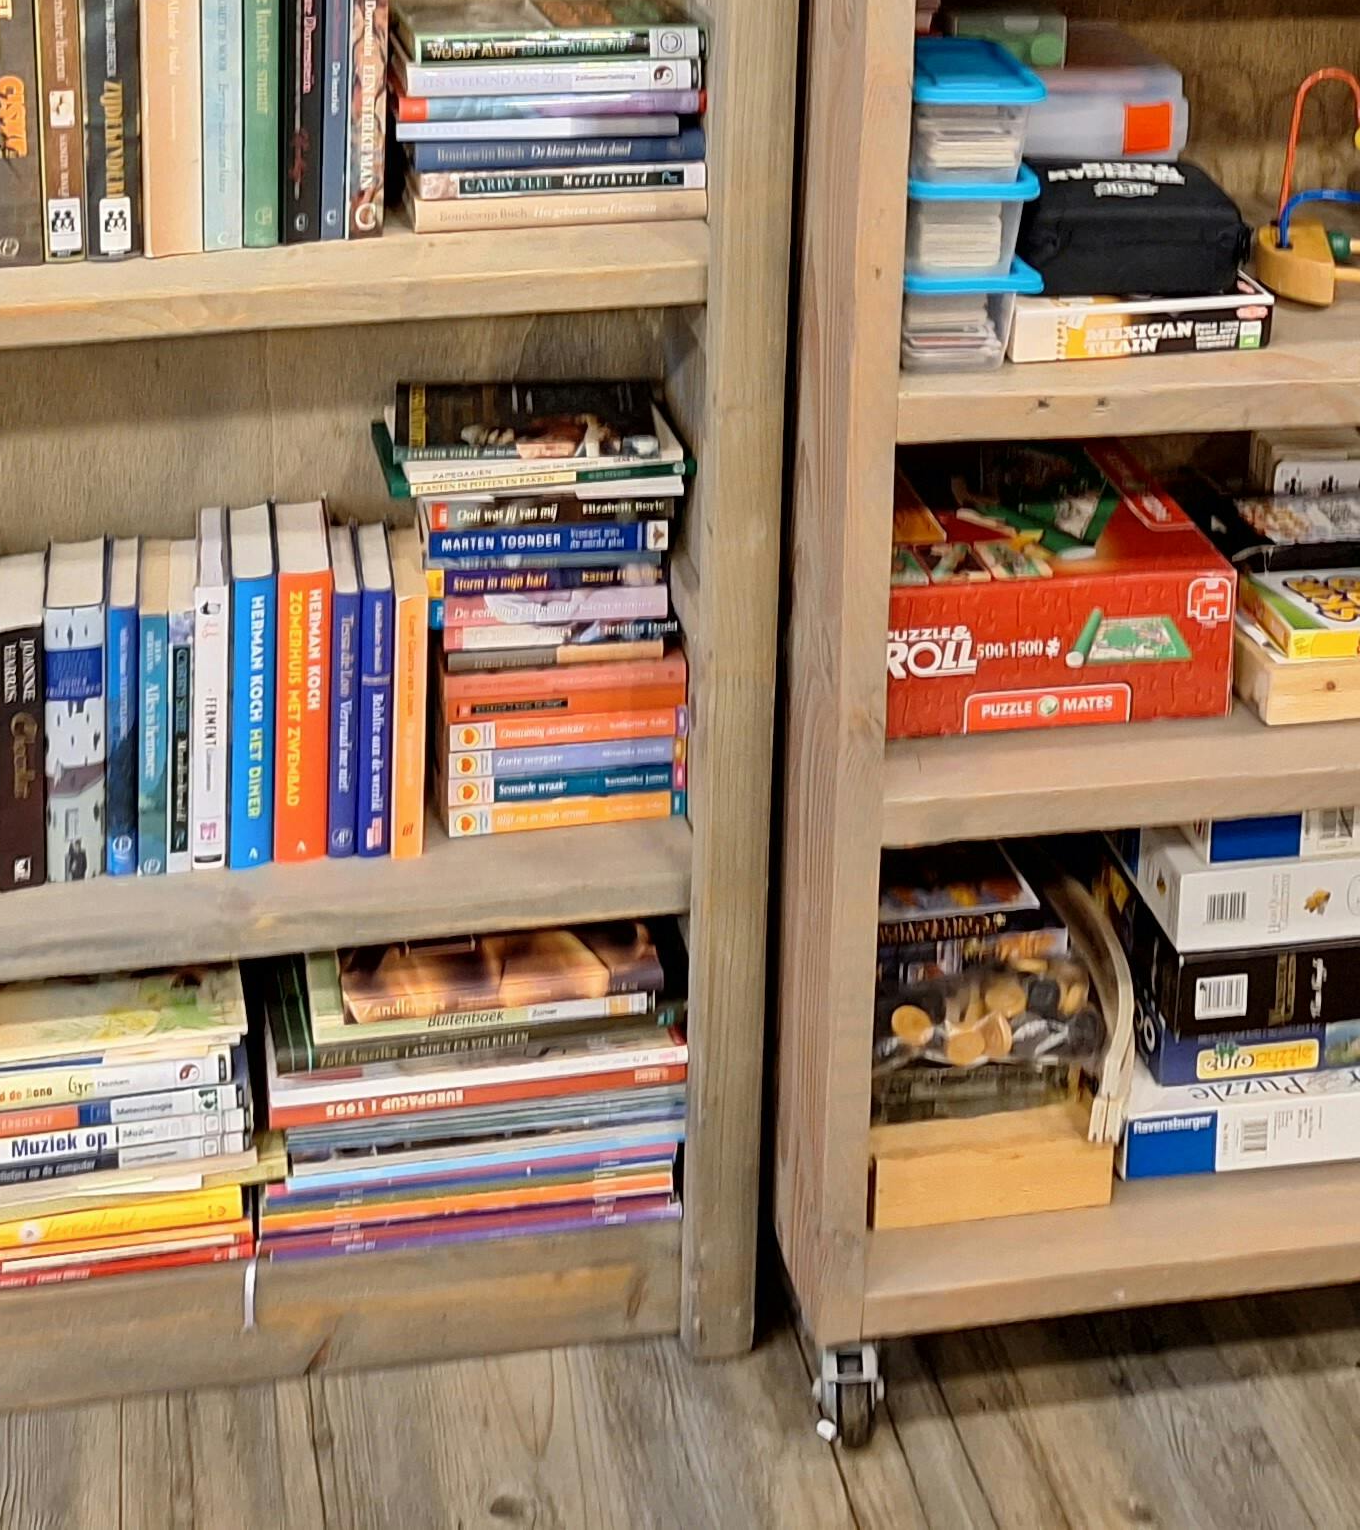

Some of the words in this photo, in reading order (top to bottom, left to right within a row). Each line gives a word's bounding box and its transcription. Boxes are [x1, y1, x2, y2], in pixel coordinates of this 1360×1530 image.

[364, 0, 376, 57] Dorrestein
[363, 64, 378, 92] EEN
[448, 74, 510, 87] WEEKEND
[361, 95, 376, 153] STERKE
[531, 145, 545, 158] De
[608, 141, 631, 156] dood
[360, 156, 375, 190] MAN
[464, 177, 514, 192] CARRY
[562, 171, 649, 187] Moederkruid
[1086, 321, 1194, 340] MEXICAN
[1085, 339, 1158, 354] TRAIN
[415, 482, 456, 494] PLANTEN
[521, 475, 555, 486] BAKKEN
[432, 469, 492, 480] PAPEGAAIEN
[484, 507, 503, 520] was
[519, 505, 538, 519] van
[539, 504, 558, 521] mij
[441, 535, 495, 553] MARTEN
[501, 532, 561, 549] TOONDER
[250, 595, 265, 670] HERMAN
[288, 590, 302, 685] ZOMERHUIS
[308, 588, 322, 660] HERMAN
[3, 643, 18, 704] HARRIS
[887, 641, 977, 679] ROLL
[145, 682, 160, 714] Alles
[250, 674, 263, 722] KOCH
[308, 664, 321, 710] KOCH
[287, 689, 301, 722] MET
[981, 700, 1033, 718] PUZZLE
[1063, 695, 1113, 711] MATES
[204, 697, 217, 746] FERMENT
[248, 728, 262, 762] HET
[286, 726, 301, 807] ZWEMBAD
[247, 766, 261, 818] DINER
[371, 774, 384, 812] wereld
[427, 1010, 505, 1028] Buitenboek
[1202, 1051, 1254, 1073] euro
[9, 1091, 22, 1101] de
[380, 1089, 464, 1112] EUROPACUP
[1189, 1075, 1306, 1102] Puzzle
[115, 1101, 173, 1117] Meteorologie
[1133, 1115, 1213, 1135] Ravensburger
[11, 1136, 78, 1158] Muziek
[85, 1131, 108, 1150] op
